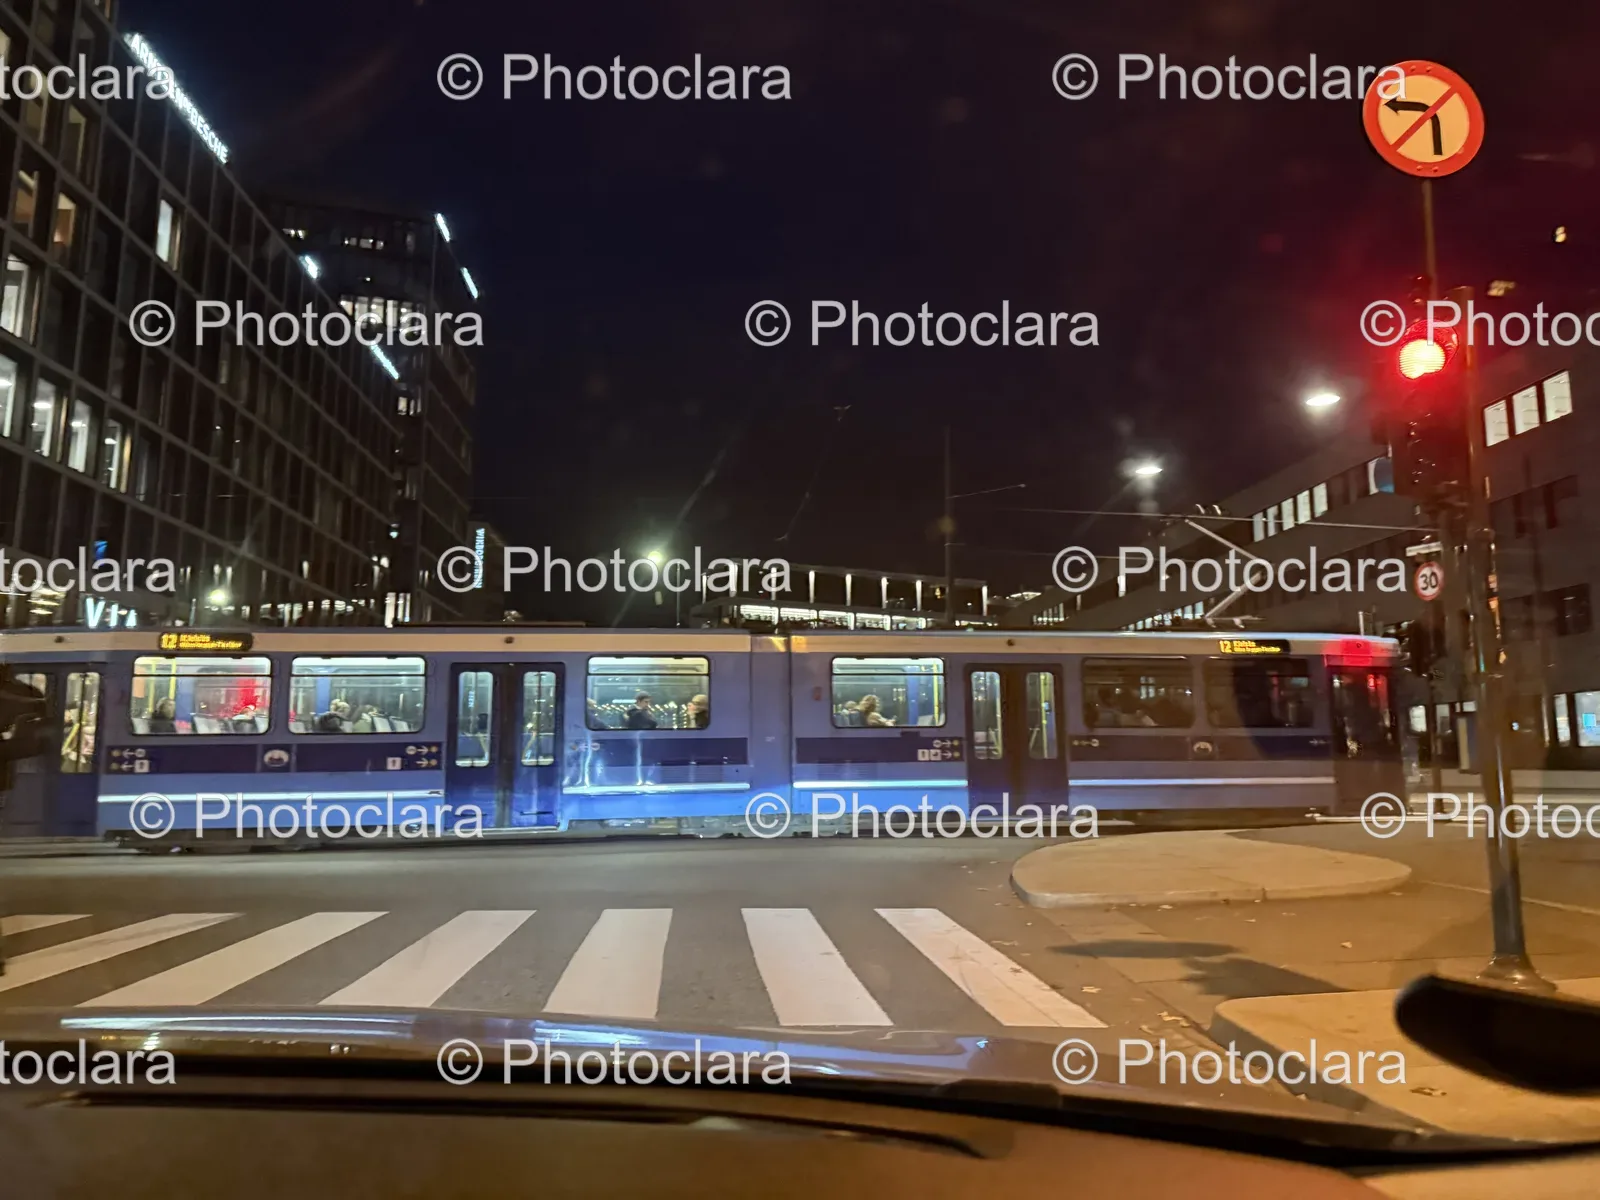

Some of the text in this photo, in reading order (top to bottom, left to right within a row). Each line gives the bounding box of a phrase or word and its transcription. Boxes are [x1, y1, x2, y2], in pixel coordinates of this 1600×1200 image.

[190, 108, 229, 163] BESCHE
[1420, 571, 1439, 591] 30
[86, 597, 137, 628] VIA
[161, 633, 177, 649] 12
[1219, 640, 1232, 653] 12
